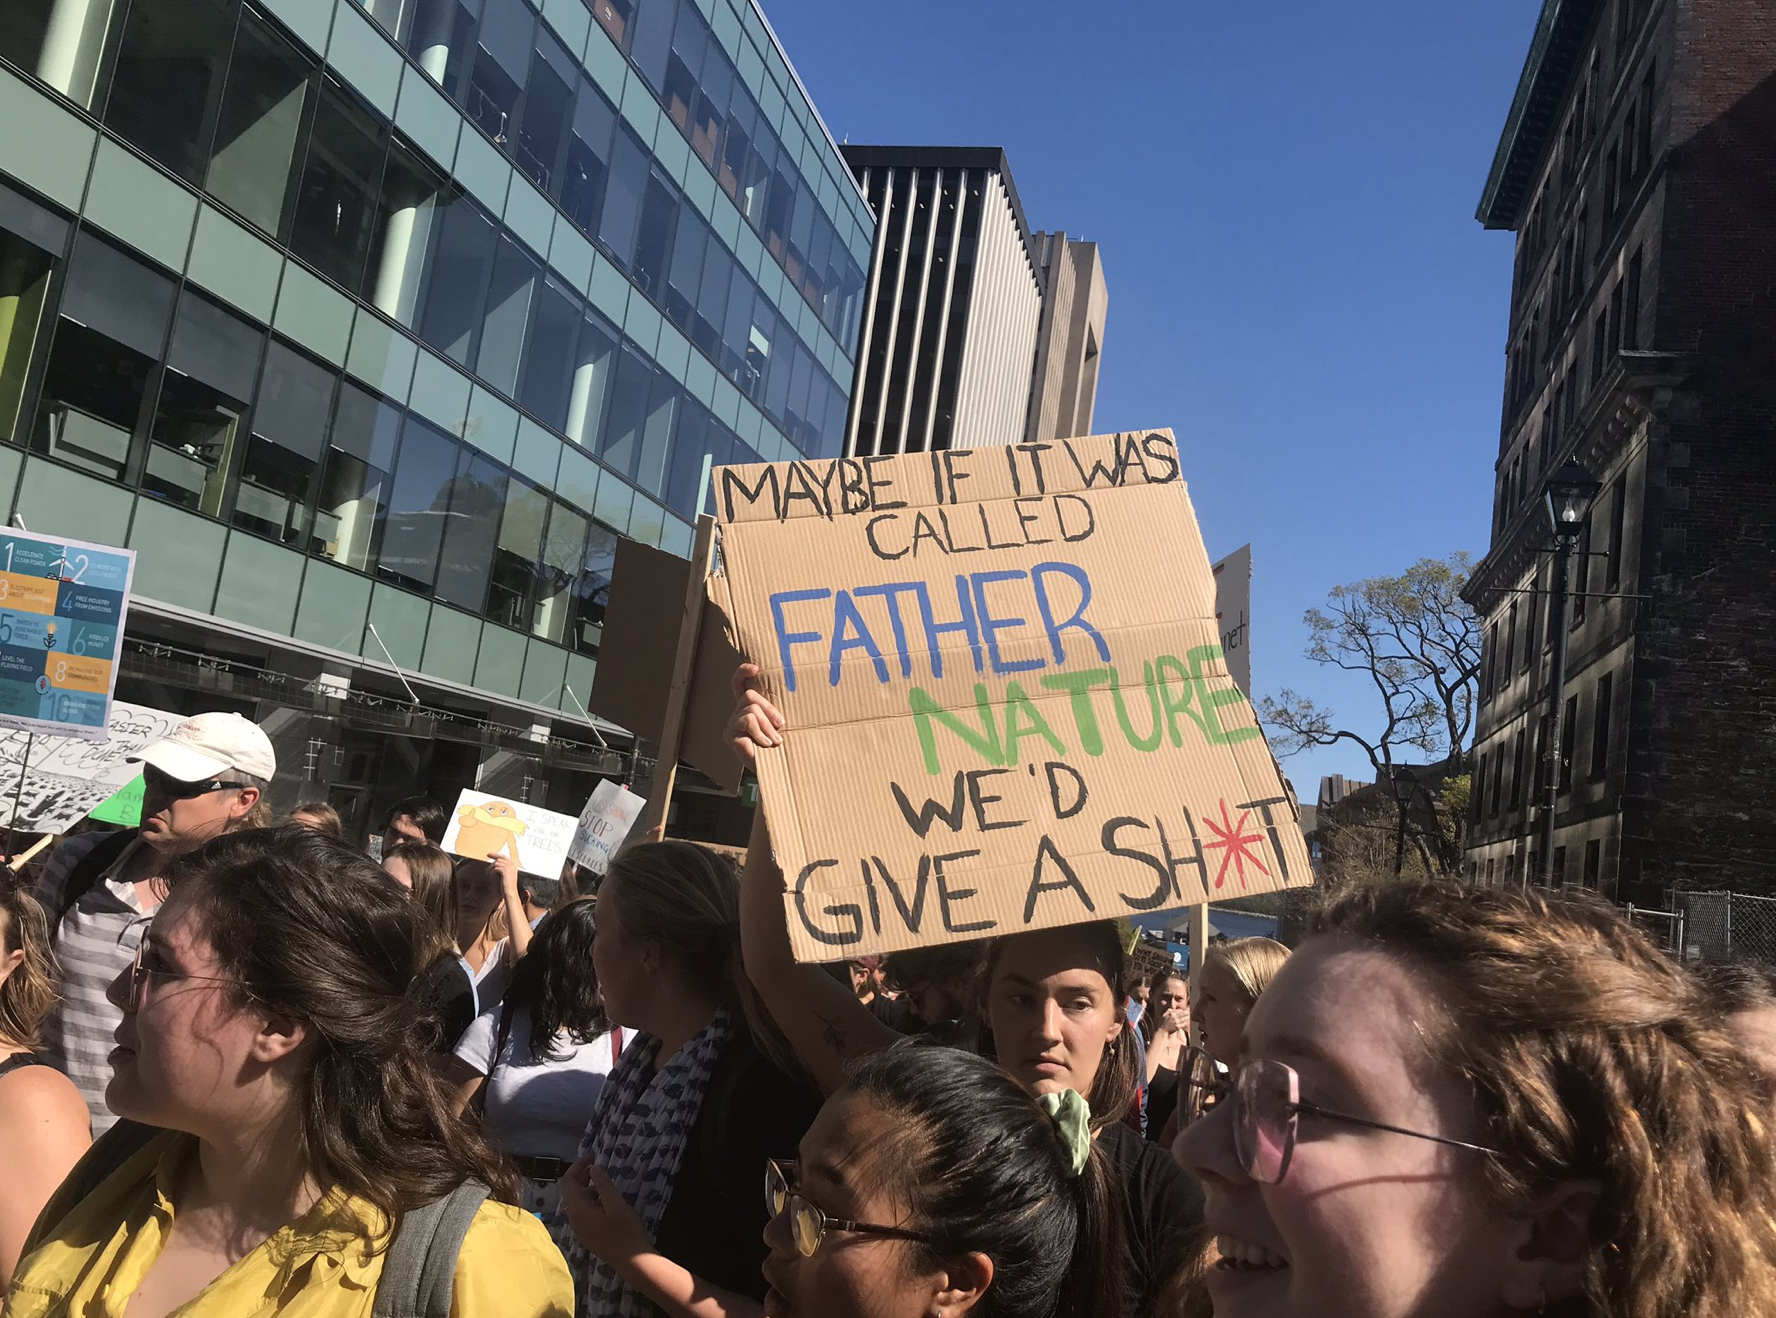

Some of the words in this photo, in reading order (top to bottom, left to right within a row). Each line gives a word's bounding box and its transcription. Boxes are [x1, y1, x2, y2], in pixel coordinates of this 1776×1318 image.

[722, 456, 908, 524] MAYBE
[931, 450, 973, 505] IF
[1005, 443, 1052, 496] IT
[1063, 432, 1179, 488] WAS
[866, 494, 1095, 560] CALLED
[5, 542, 14, 572] 1
[72, 554, 89, 585] 2
[62, 590, 73, 612] 4
[0, 612, 14, 643] 5
[72, 626, 86, 656] 6
[769, 561, 1111, 692] FATHER
[1220, 610, 1246, 653] net
[55, 661, 67, 682] 8
[49, 692, 71, 723] 10
[908, 644, 1260, 775] NATURE
[108, 719, 152, 738] ASIER
[890, 761, 1089, 839] WE'D
[541, 813, 572, 829] SPEAK
[580, 810, 614, 837] STOP
[527, 835, 562, 852] TREES
[580, 830, 610, 855] SUCKING
[795, 849, 997, 945] GIVE
[1023, 833, 1095, 924] A
